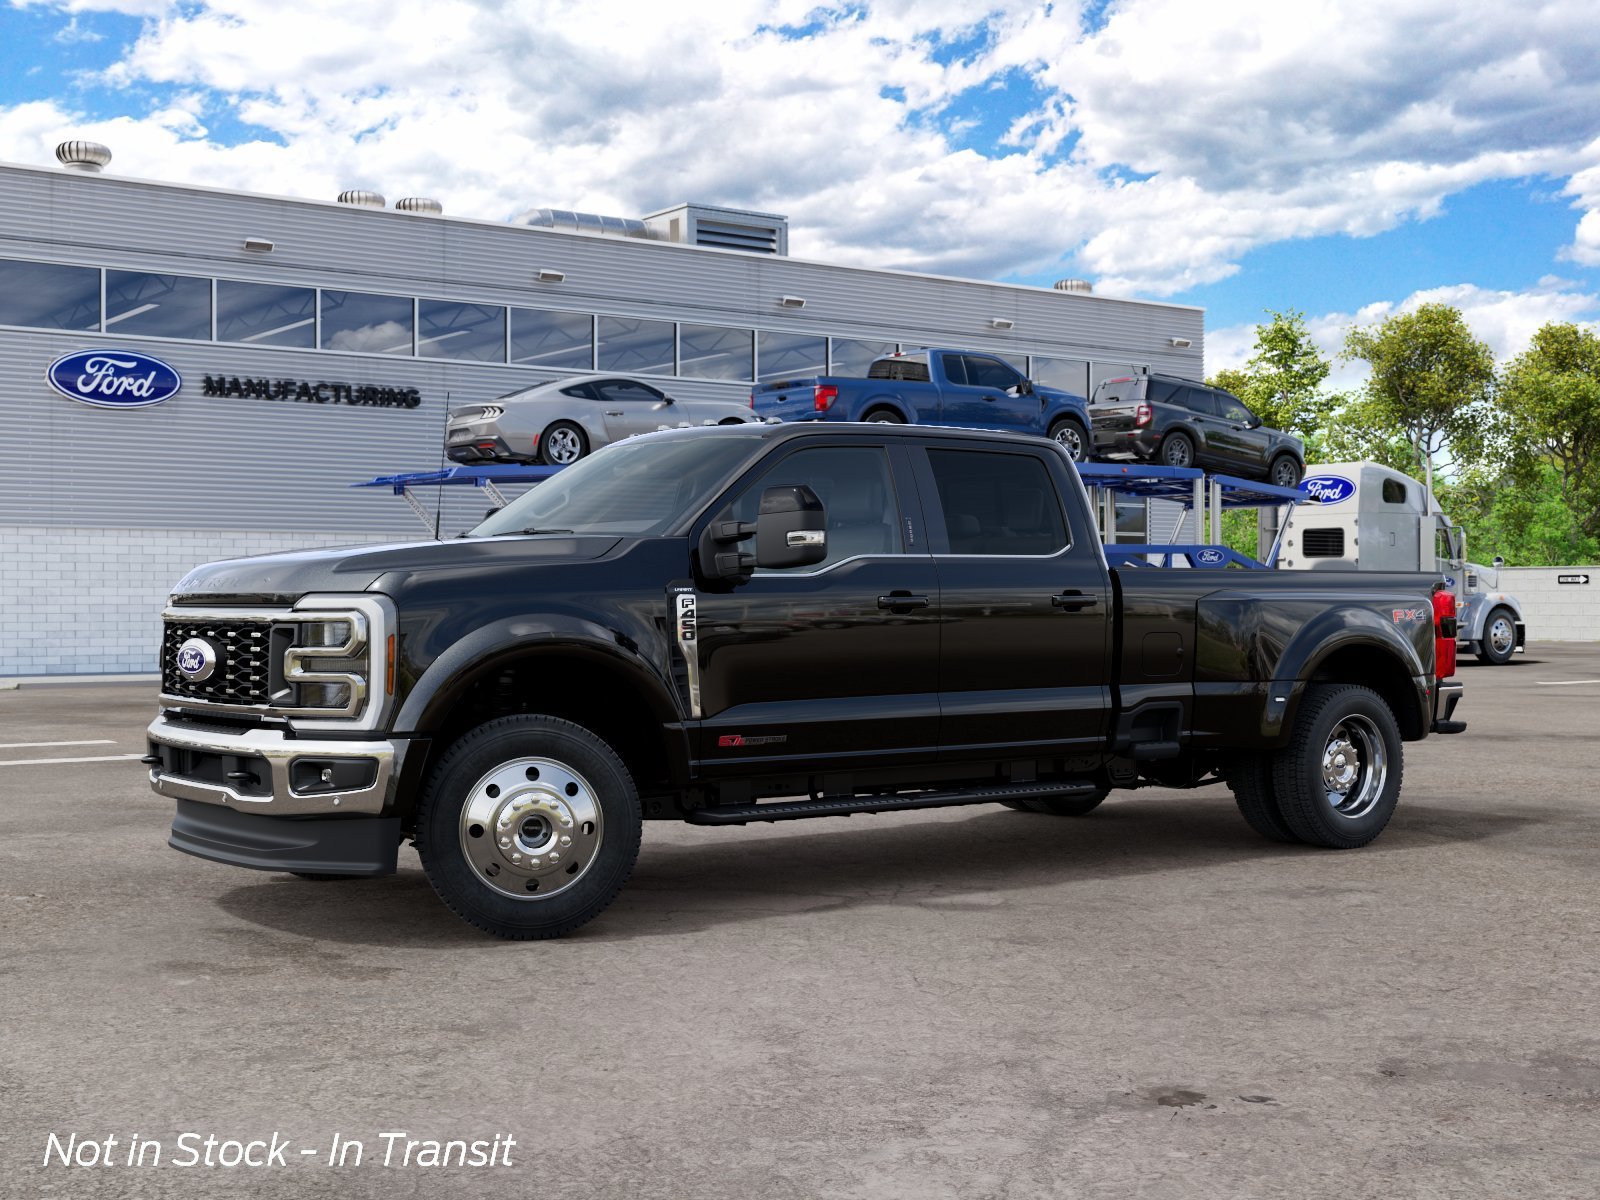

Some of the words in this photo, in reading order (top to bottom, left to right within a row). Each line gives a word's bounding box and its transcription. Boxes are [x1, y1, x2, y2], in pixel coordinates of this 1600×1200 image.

[76, 356, 157, 398] Ford
[203, 374, 421, 409] MANUFACTURING
[1307, 480, 1343, 500] Ford
[1392, 608, 1426, 623] FX4
[181, 649, 200, 670] Ford
